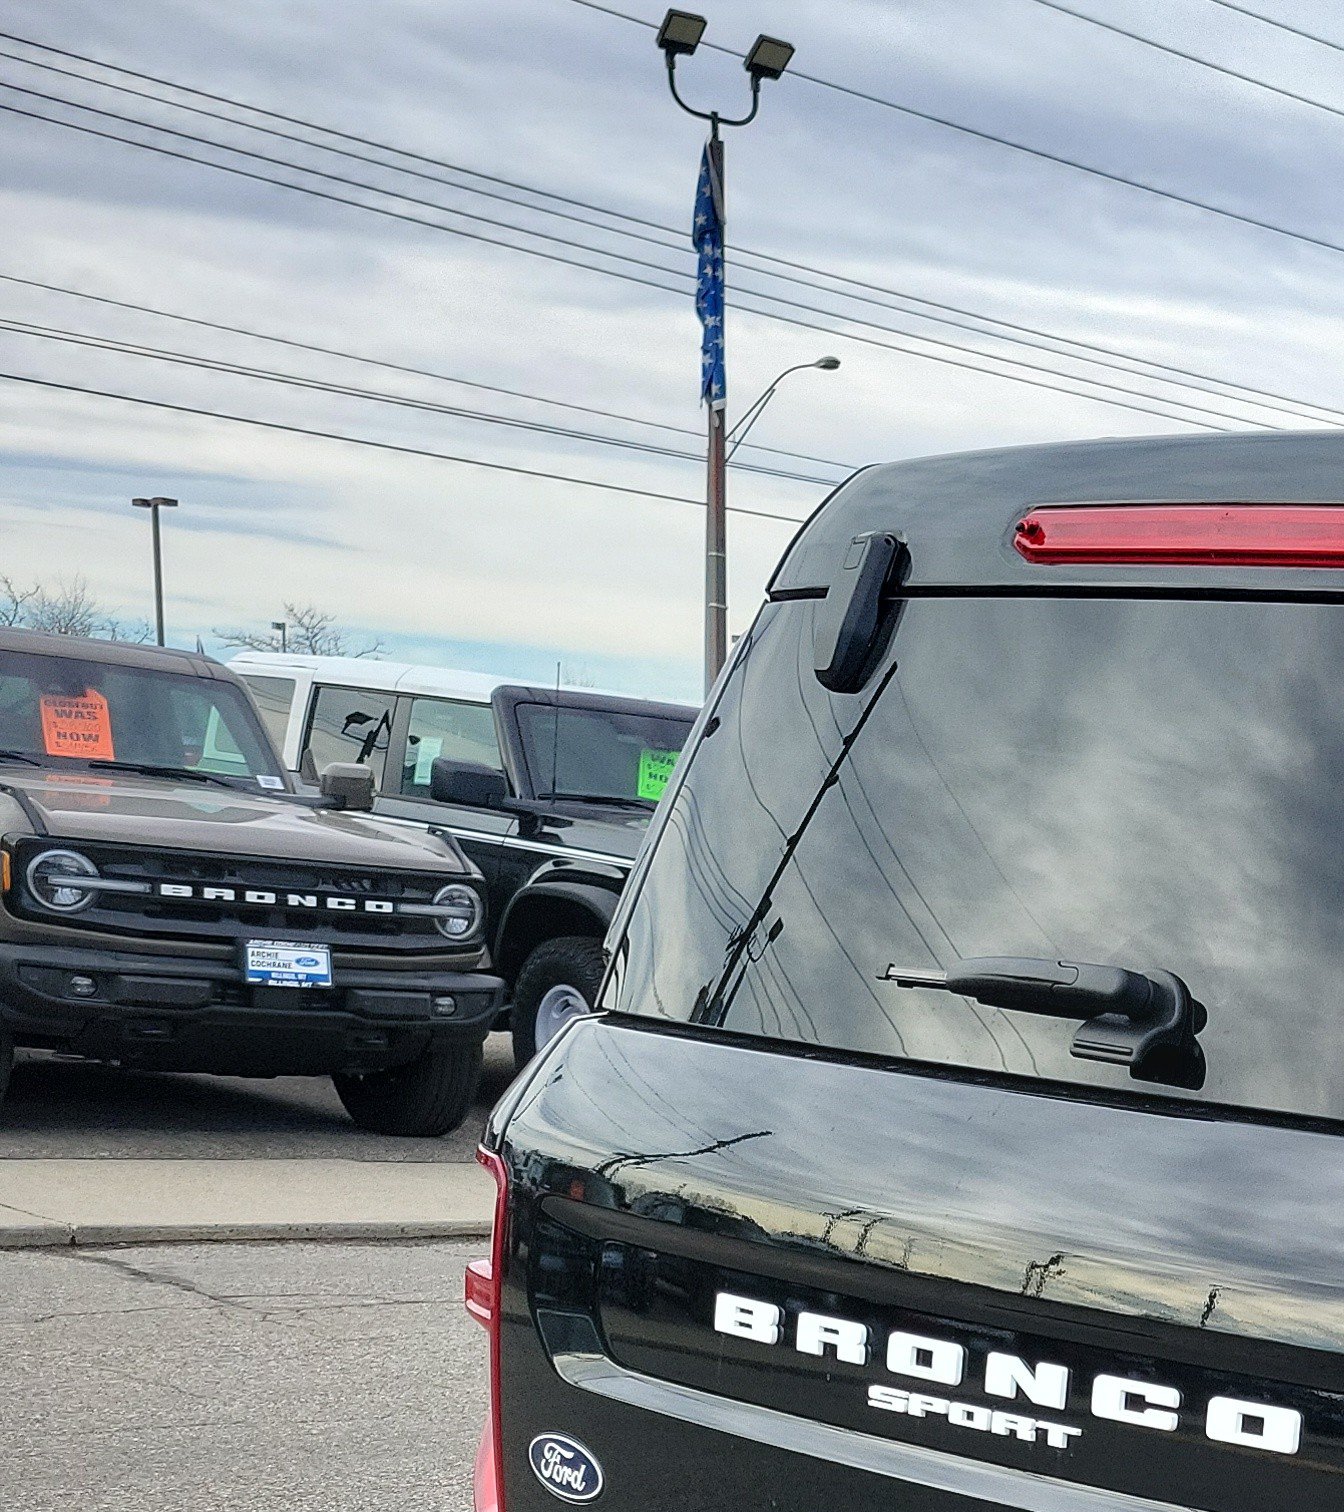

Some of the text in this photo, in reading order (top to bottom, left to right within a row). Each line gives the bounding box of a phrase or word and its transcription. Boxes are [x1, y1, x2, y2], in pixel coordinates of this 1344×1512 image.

[160, 884, 394, 913] BRONCO
[250, 950, 279, 960] ARCHIE
[250, 960, 293, 969] COCHRANE
[714, 1291, 1302, 1454] BRONCO
[867, 1384, 1082, 1449] SPORT
[539, 1441, 588, 1493] Ford
